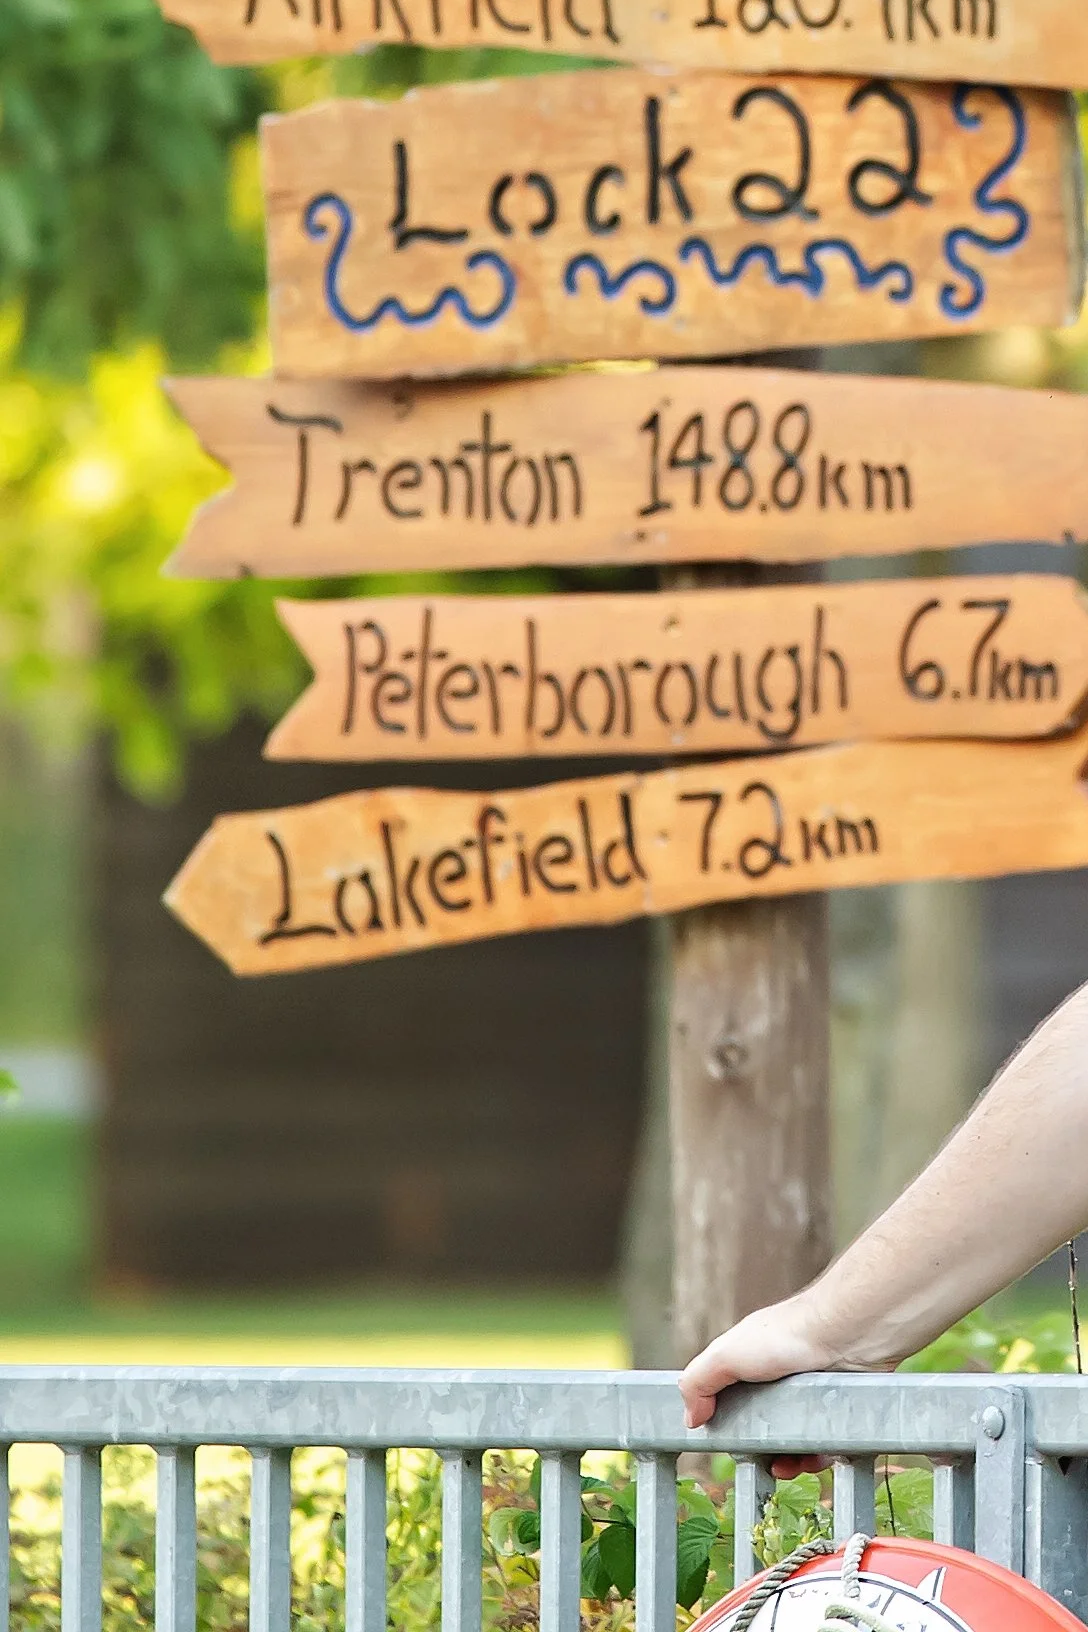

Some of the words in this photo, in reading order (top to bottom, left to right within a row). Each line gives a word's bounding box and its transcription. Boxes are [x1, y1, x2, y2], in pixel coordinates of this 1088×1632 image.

[388, 94, 696, 252] Lock
[730, 78, 934, 224] 22
[265, 402, 583, 528] Trenton
[341, 604, 850, 742] Peterborough
[256, 791, 648, 946] Lakefield
